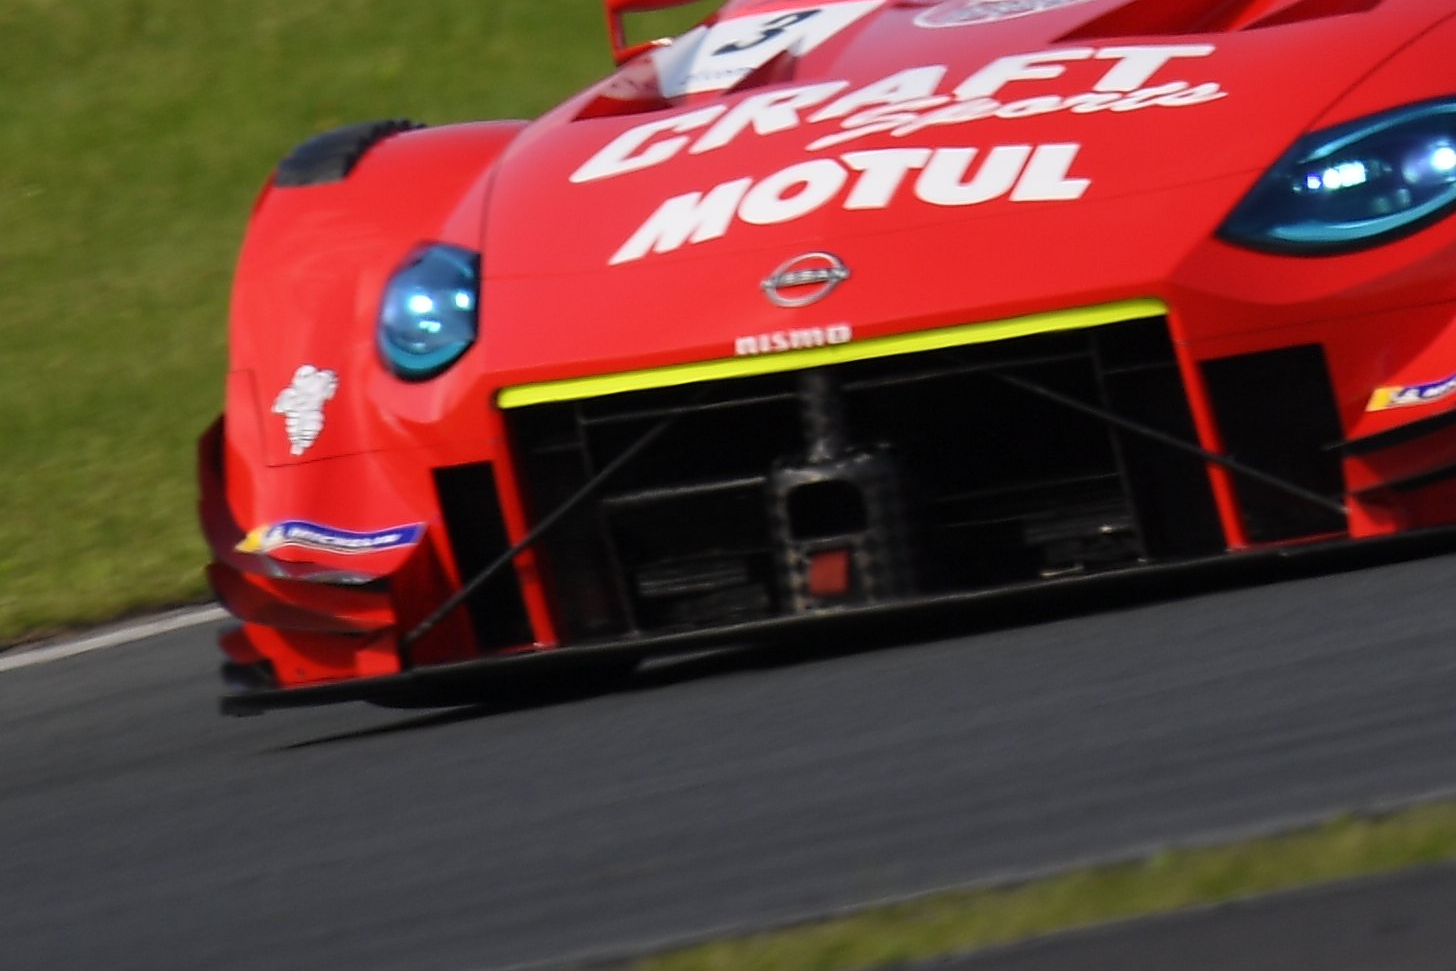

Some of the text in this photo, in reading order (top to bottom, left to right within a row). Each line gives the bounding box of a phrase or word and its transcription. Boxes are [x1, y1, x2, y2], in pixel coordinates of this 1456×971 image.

[712, 9, 822, 56] 3
[570, 44, 1215, 182] CRAFT
[807, 83, 1228, 149] Sports
[609, 143, 1091, 264] MOTUL
[735, 325, 852, 355] nismo
